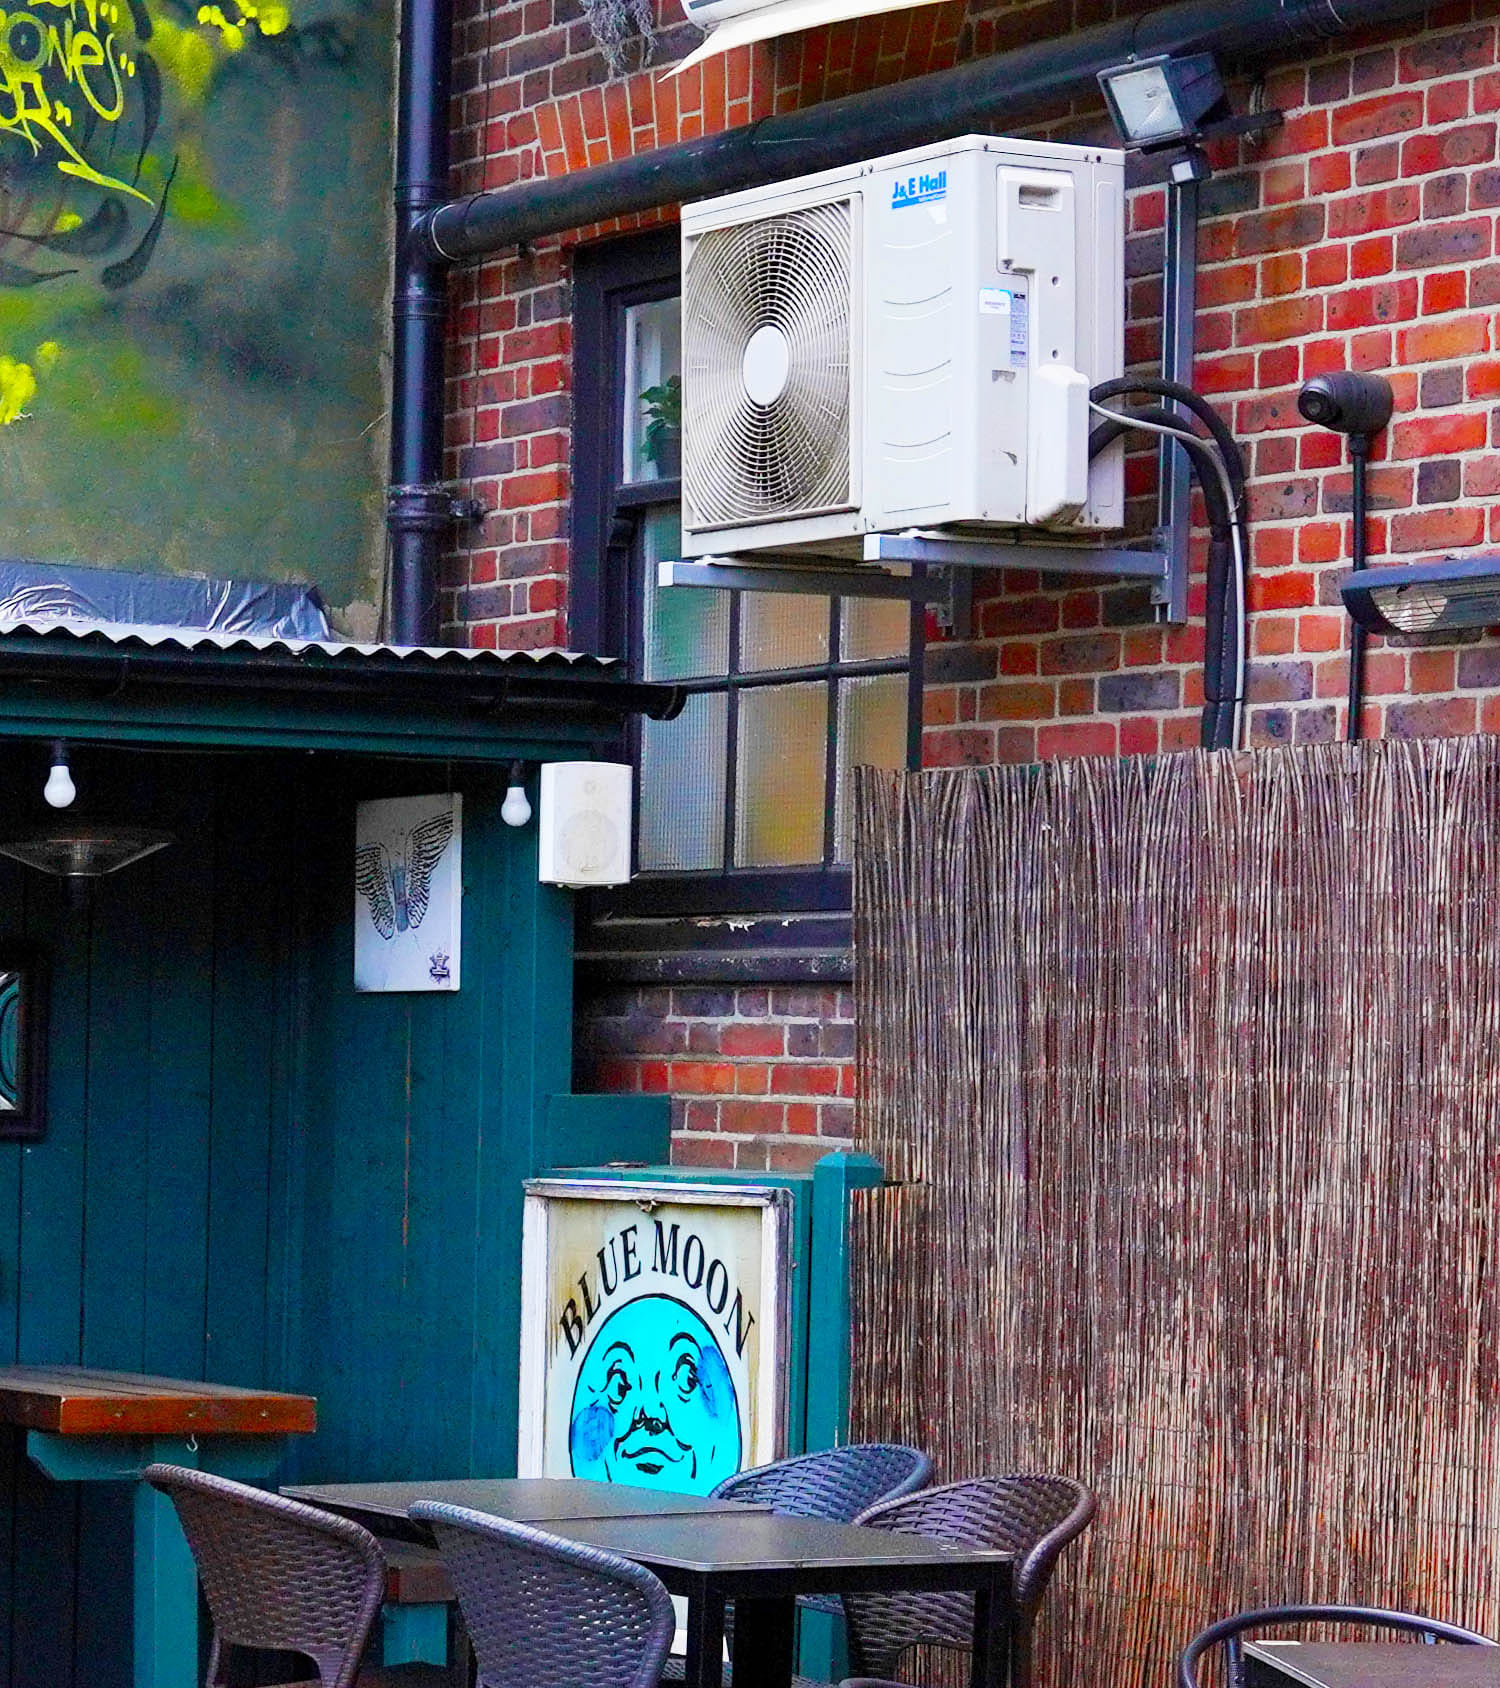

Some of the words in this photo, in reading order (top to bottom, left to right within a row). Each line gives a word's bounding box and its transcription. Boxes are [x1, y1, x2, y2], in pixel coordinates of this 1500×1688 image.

[919, 170, 947, 194] Hall
[560, 1224, 642, 1361] BLUE
[651, 1219, 756, 1361] MOON
